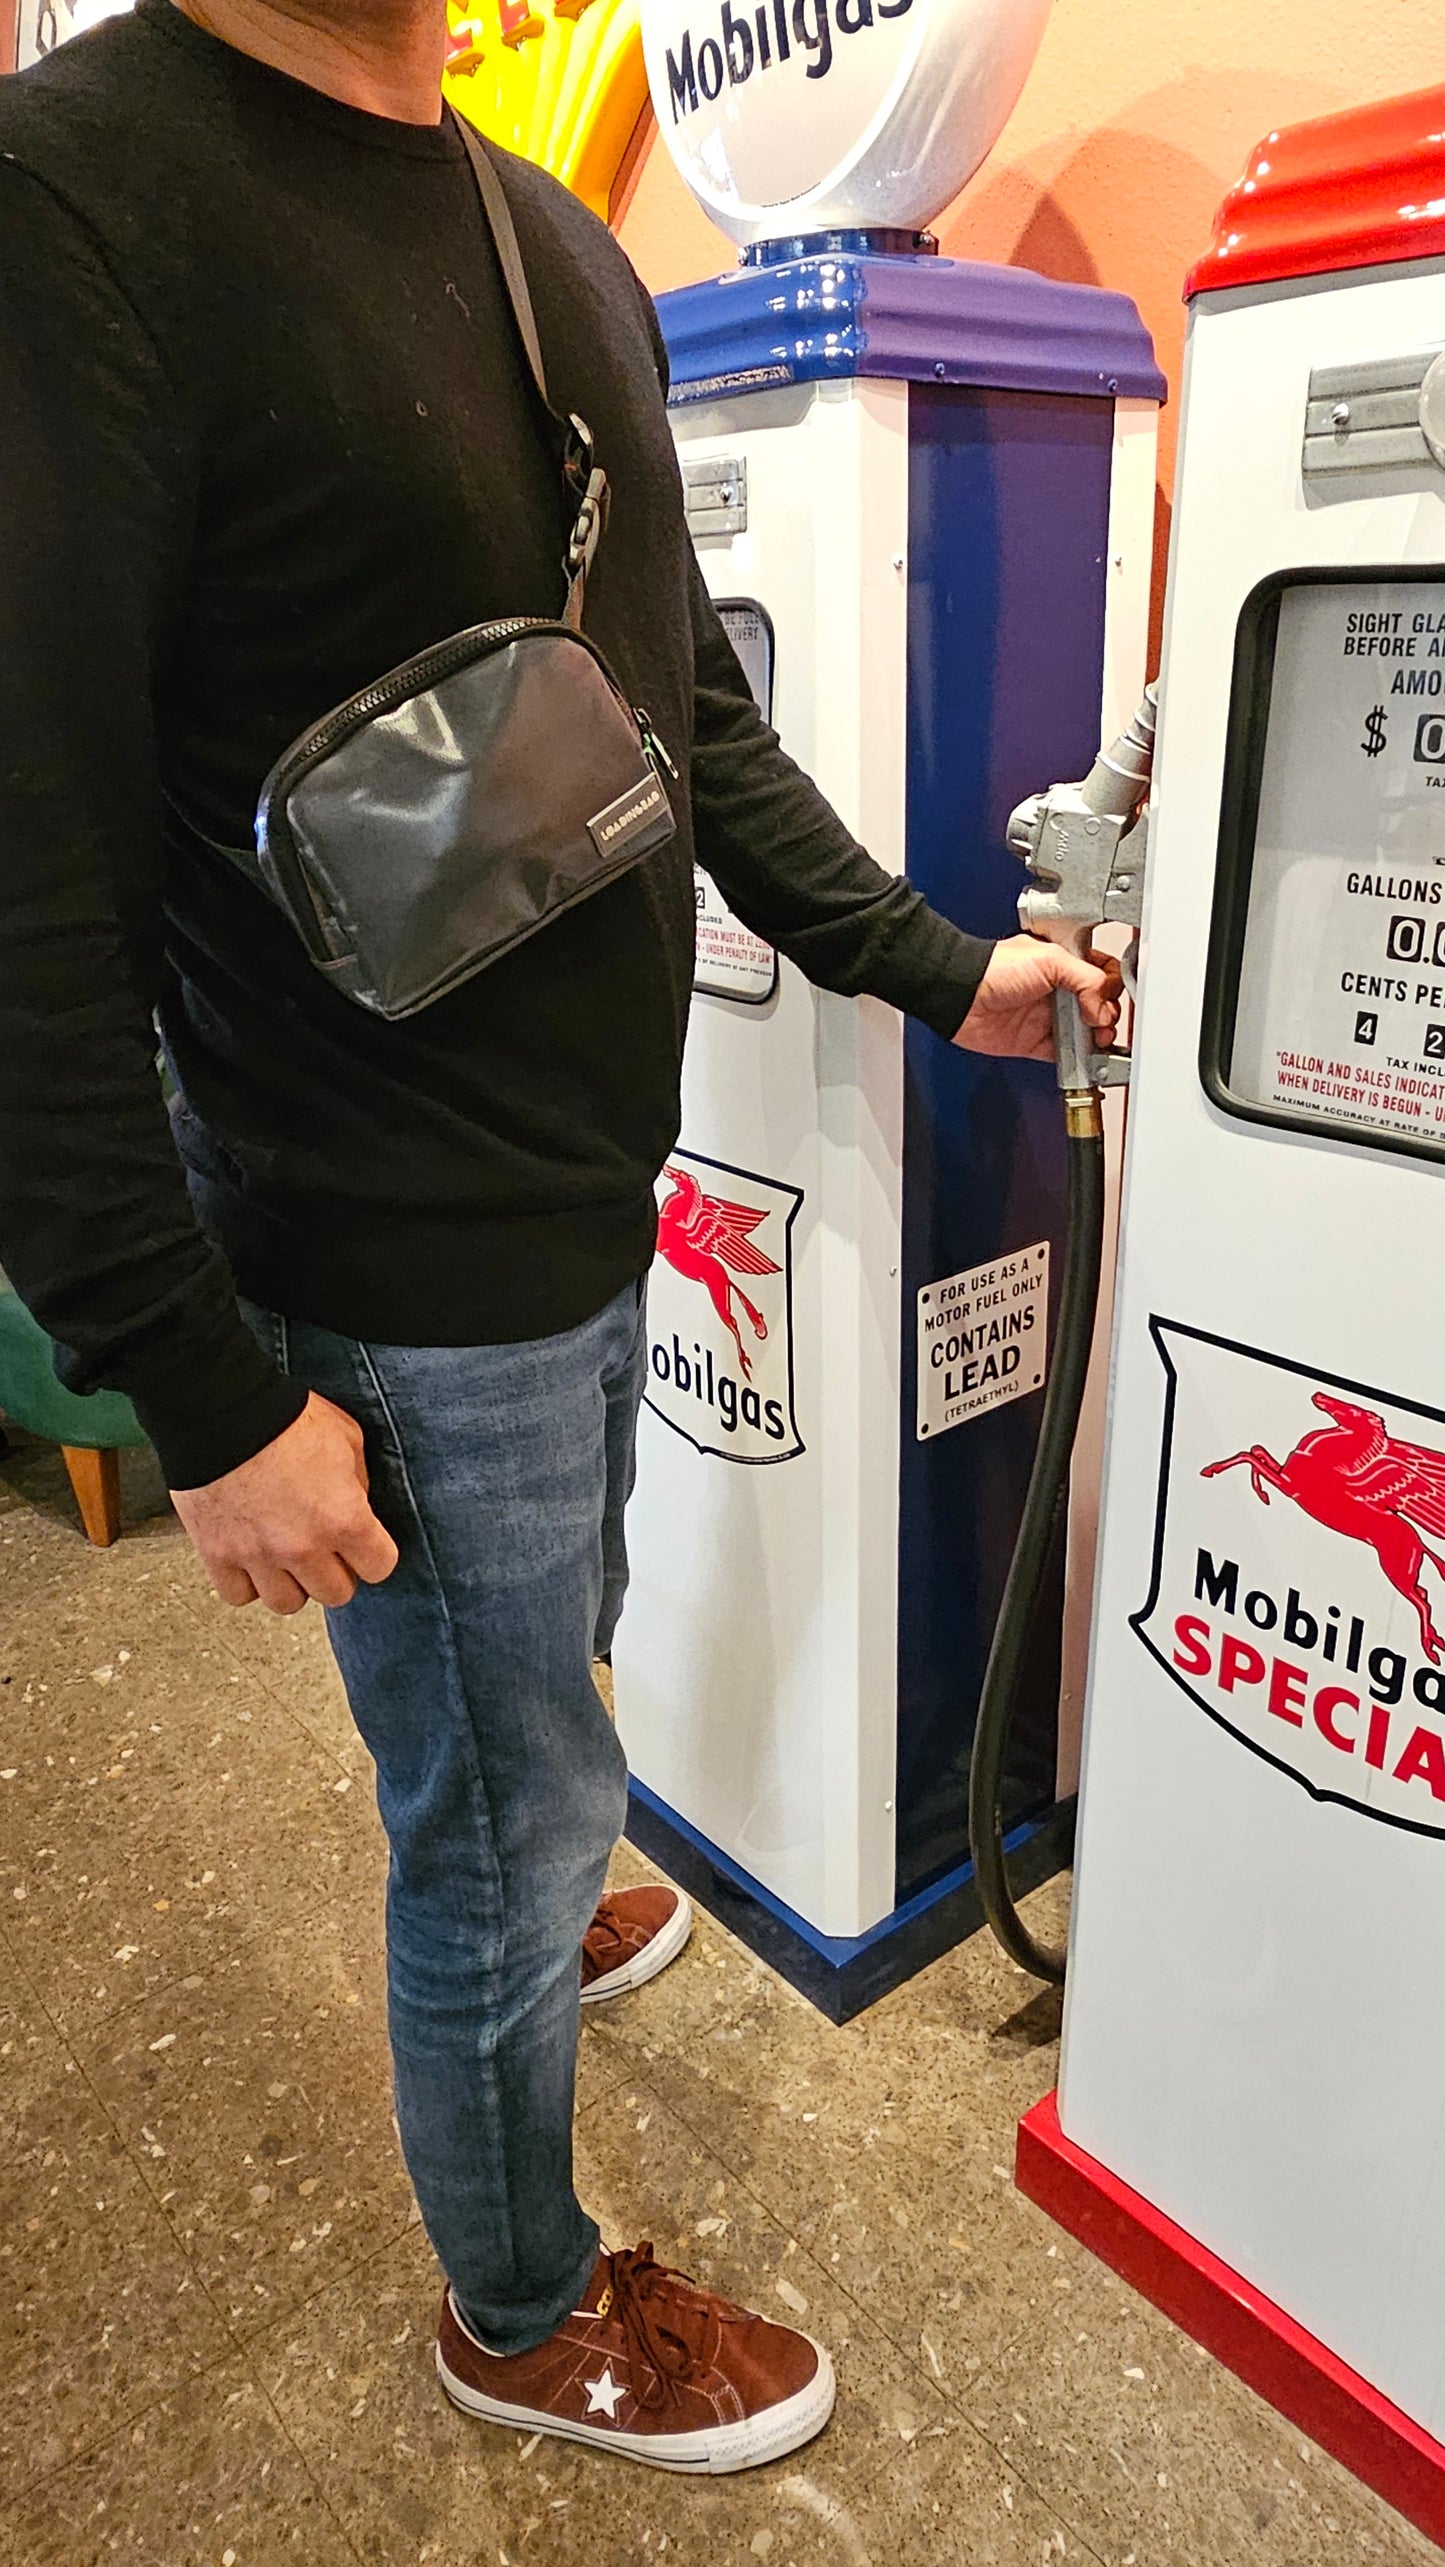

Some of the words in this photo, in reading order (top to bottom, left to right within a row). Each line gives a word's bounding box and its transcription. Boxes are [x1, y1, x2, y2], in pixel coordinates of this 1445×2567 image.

[1346, 613, 1403, 633] SIGHT
[1344, 637, 1417, 657] BEFORE
[1427, 637, 1445, 657] A
[1390, 669, 1445, 696] AMO
[1360, 704, 1388, 758] $
[1347, 873, 1443, 904] GALLONS
[697, 914, 722, 924] CLUDED
[1393, 920, 1445, 966] 0.
[1341, 971, 1408, 1002] CENTS
[1415, 984, 1445, 1008] PE
[1358, 1018, 1373, 1040] 4
[1427, 1031, 1444, 1053] 2
[1276, 1051, 1324, 1074] "GALLON
[1327, 1062, 1351, 1079] AND
[1354, 1068, 1392, 1089] SALES
[1395, 1076, 1445, 1100] INDICAT
[1386, 1056, 1410, 1070] TAX
[1414, 1062, 1445, 1077] INCL
[1273, 1094, 1320, 1110] MAXIMUM
[1323, 1106, 1376, 1123] ACCURACY
[1379, 1118, 1390, 1126] AT
[1394, 1122, 1418, 1133] RATE
[1423, 1128, 1436, 1136] OF
[1277, 1070, 1308, 1090] WHEN
[1312, 1078, 1366, 1104] DELIVERY
[1368, 1091, 1379, 1107] IS
[1382, 1095, 1421, 1117] BEGUN
[1435, 1106, 1445, 1123] U
[925, 1303, 970, 1333] MOTOR
[976, 1288, 1007, 1312] FUEL
[1012, 1273, 1043, 1297] ONLY
[940, 1282, 966, 1304] FOR
[971, 1270, 996, 1292] USE
[1000, 1263, 1016, 1281] AS
[1021, 1258, 1029, 1273] A
[931, 1305, 1035, 1368] CONTAINS
[652, 1333, 785, 1441] obilgas
[944, 1345, 1020, 1401] LEAD
[944, 1380, 1019, 1422] (TETRAETHYL)
[1194, 1547, 1445, 1715] Mobilga
[1173, 1614, 1445, 1803] SPECIA
